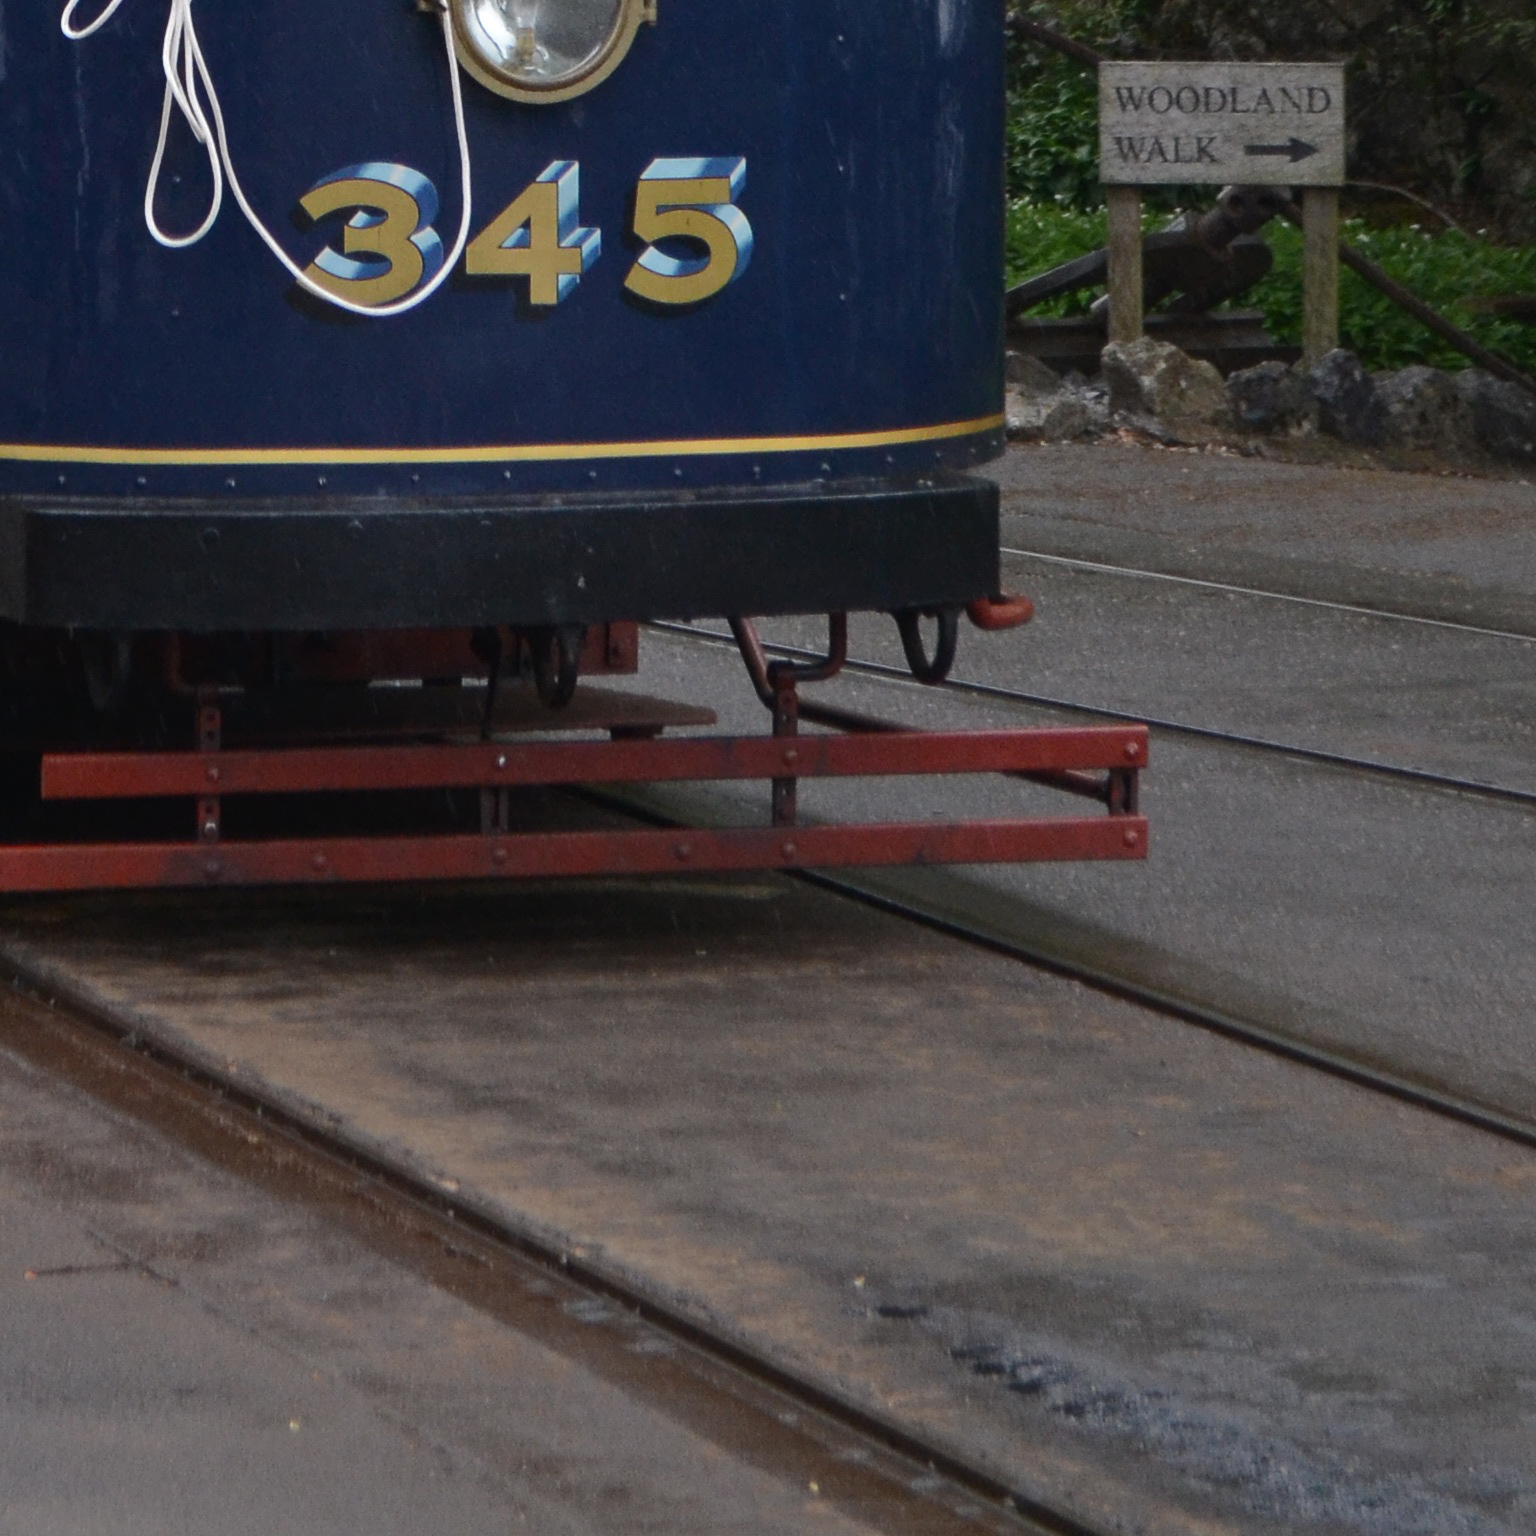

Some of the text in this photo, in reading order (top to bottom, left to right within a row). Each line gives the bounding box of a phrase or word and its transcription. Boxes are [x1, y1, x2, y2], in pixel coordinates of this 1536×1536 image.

[1114, 85, 1332, 115] WOODLAND
[1114, 135, 1219, 164] WALK
[296, 157, 754, 312] 345
